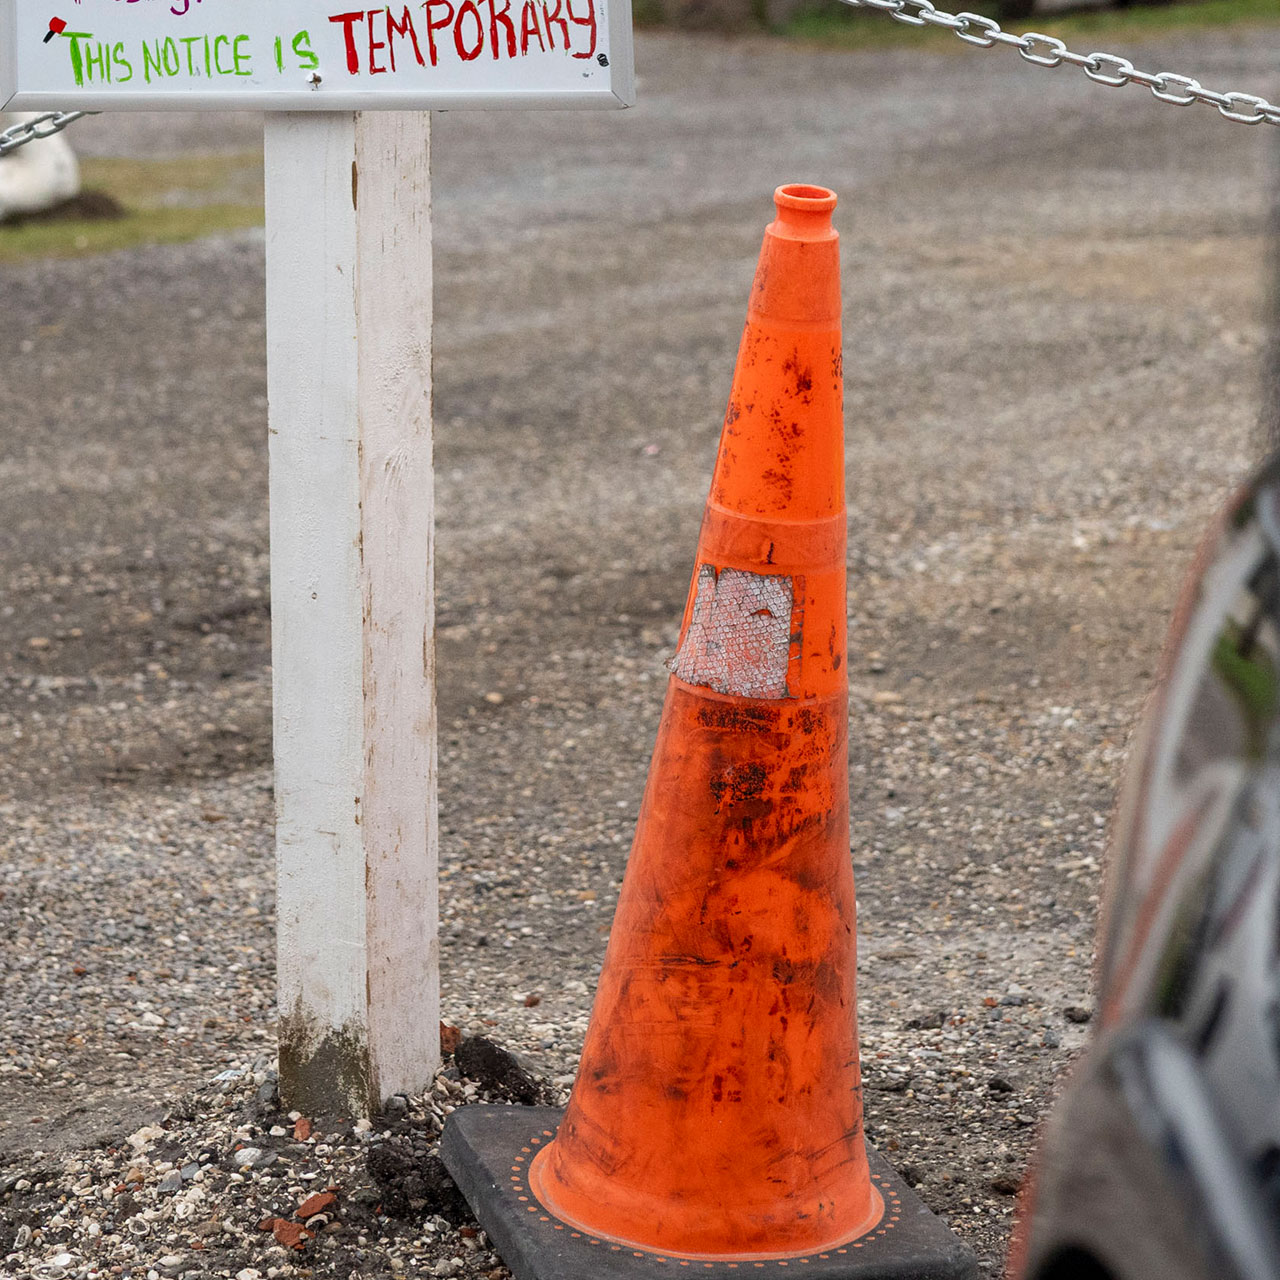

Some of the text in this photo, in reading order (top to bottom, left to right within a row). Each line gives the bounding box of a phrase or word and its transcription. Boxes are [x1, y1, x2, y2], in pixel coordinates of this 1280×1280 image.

[60, 31, 133, 87] THIS
[143, 35, 251, 83] NOTICE
[275, 31, 318, 72] IS
